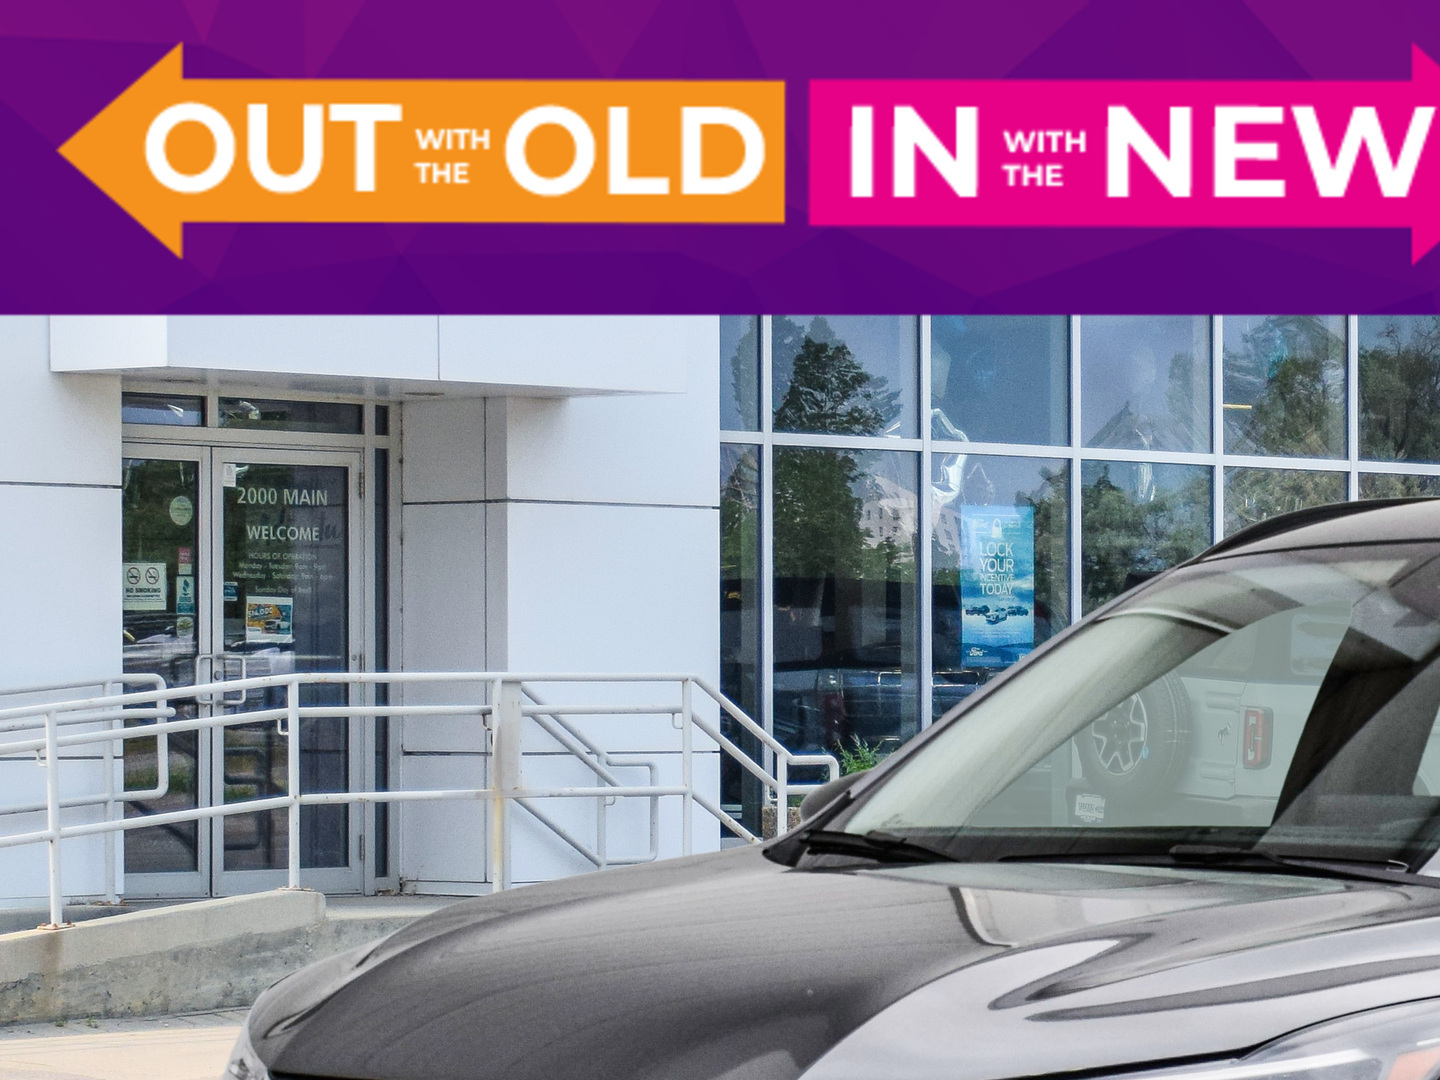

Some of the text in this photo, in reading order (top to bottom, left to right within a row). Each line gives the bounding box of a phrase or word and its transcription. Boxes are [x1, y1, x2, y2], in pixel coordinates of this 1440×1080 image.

[237, 487, 328, 506] 2000 MAIN
[246, 525, 319, 541] WELCOME
[249, 552, 271, 560] HOURS
[980, 542, 1014, 557] LOCK
[980, 558, 1014, 572] YOUR
[980, 583, 1014, 595] TODAY
